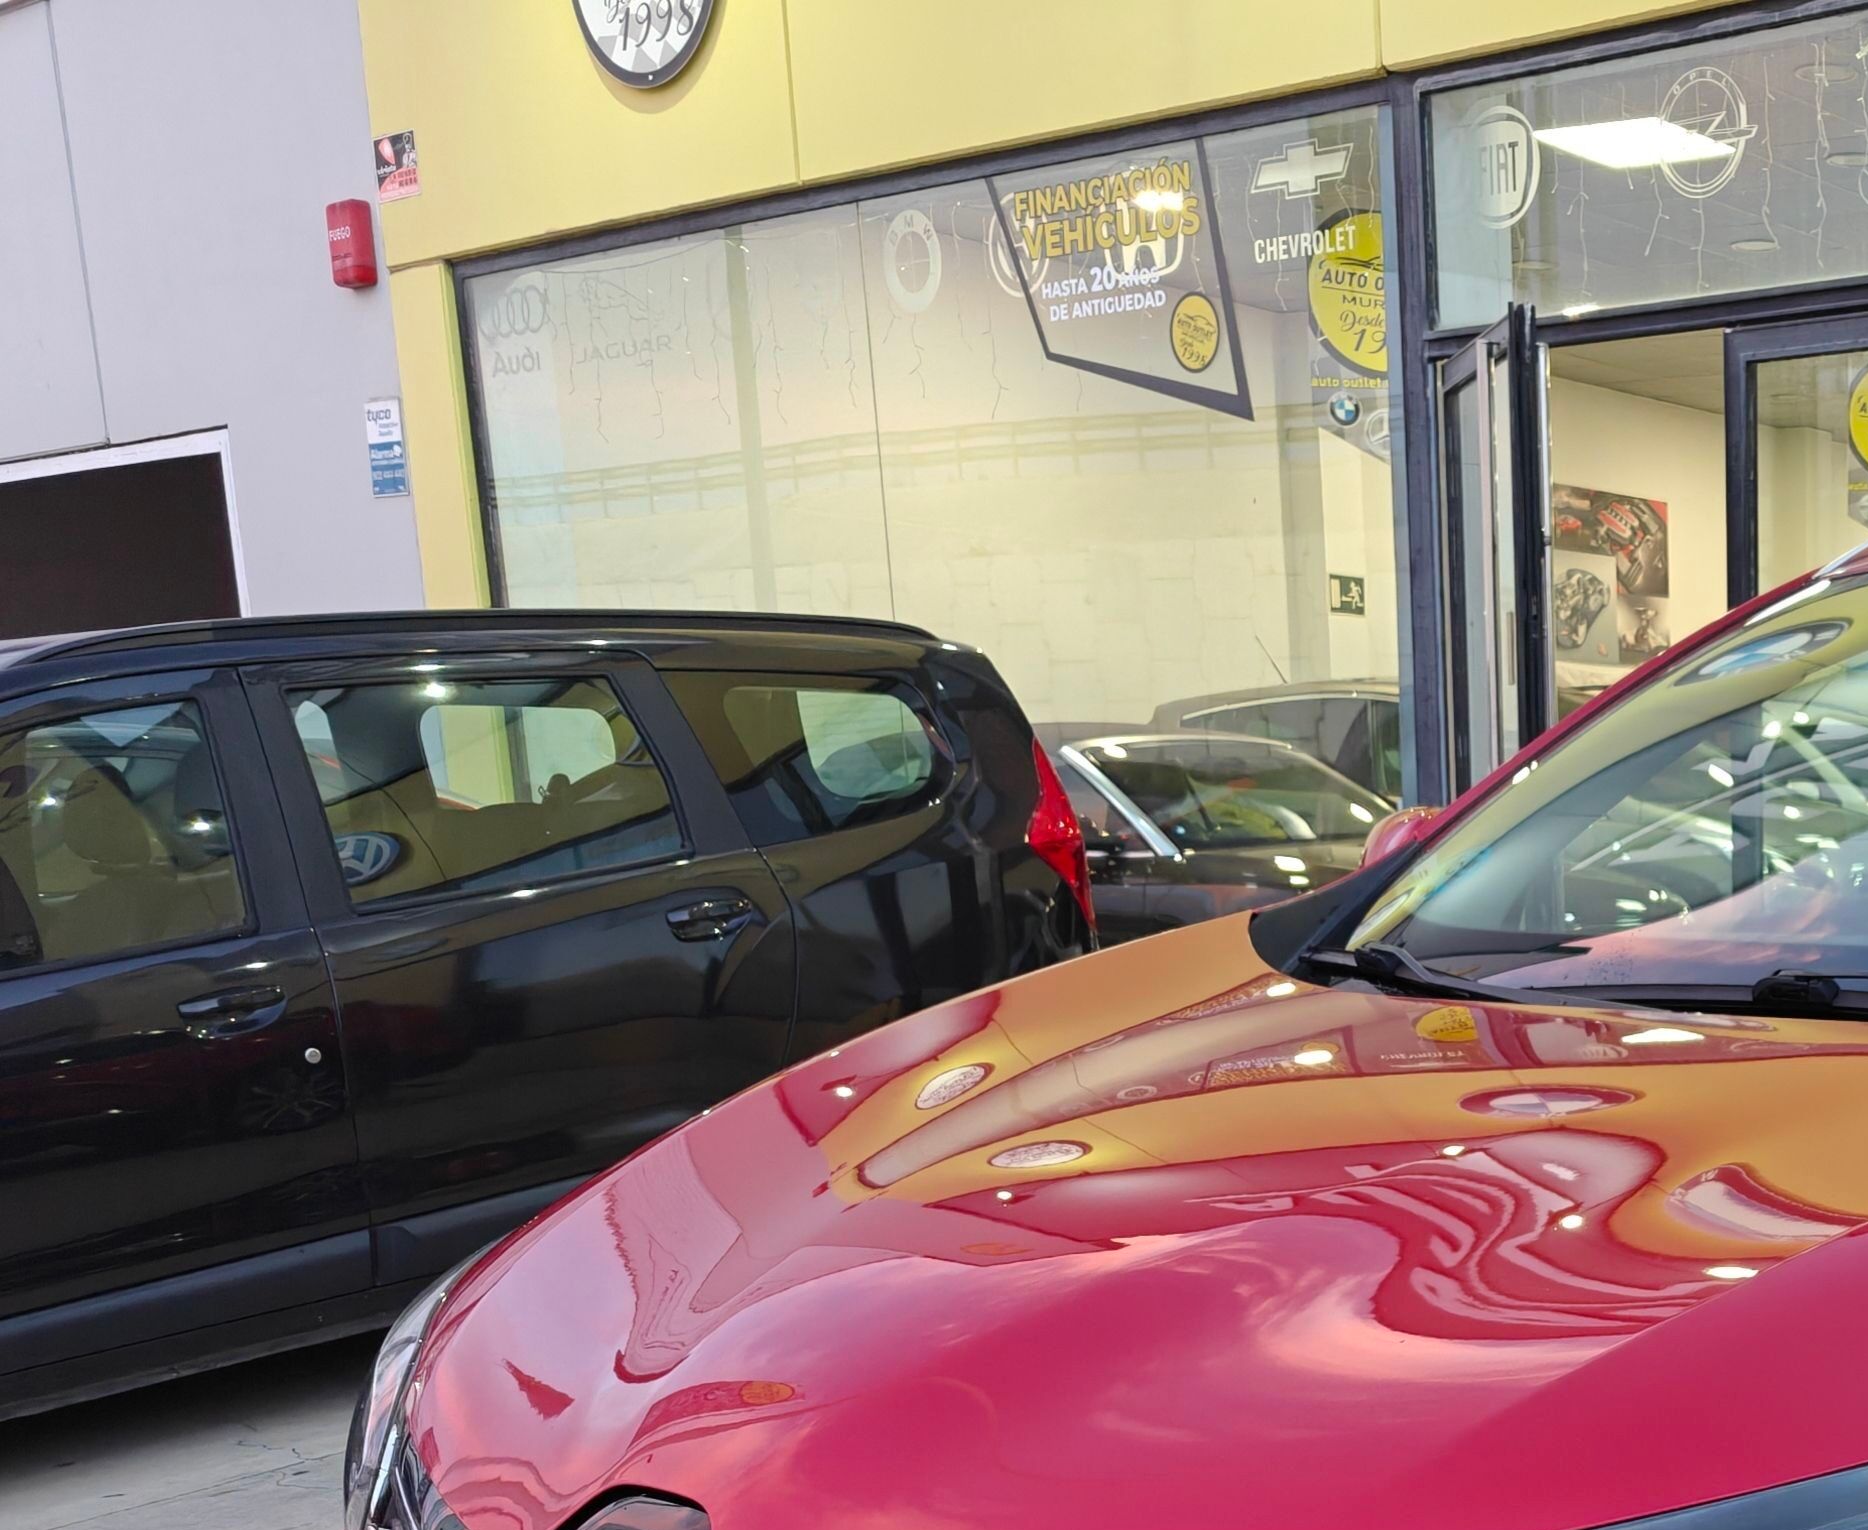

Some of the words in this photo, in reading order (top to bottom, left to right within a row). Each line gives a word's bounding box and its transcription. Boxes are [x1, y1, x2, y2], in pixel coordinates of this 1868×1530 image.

[618, 0, 694, 51] 1998
[1673, 70, 1728, 95] OPEL
[1480, 140, 1519, 196] FIAT
[1013, 156, 1191, 222] FINANCIACIÓN
[328, 225, 351, 242] FUEGO
[1022, 196, 1201, 261] VEHÍCULOS
[1254, 225, 1356, 264] CHEVROLET
[1041, 278, 1088, 300] HASTA
[1089, 266, 1116, 293] 20
[1117, 267, 1160, 288] AÑOS
[1321, 267, 1367, 290] AUTO
[1050, 303, 1069, 322] DE
[1072, 289, 1167, 319] ANTIGUEDAD
[492, 345, 541, 378] Audi
[575, 334, 672, 364] JAGUAR
[367, 408, 392, 425] tyco
